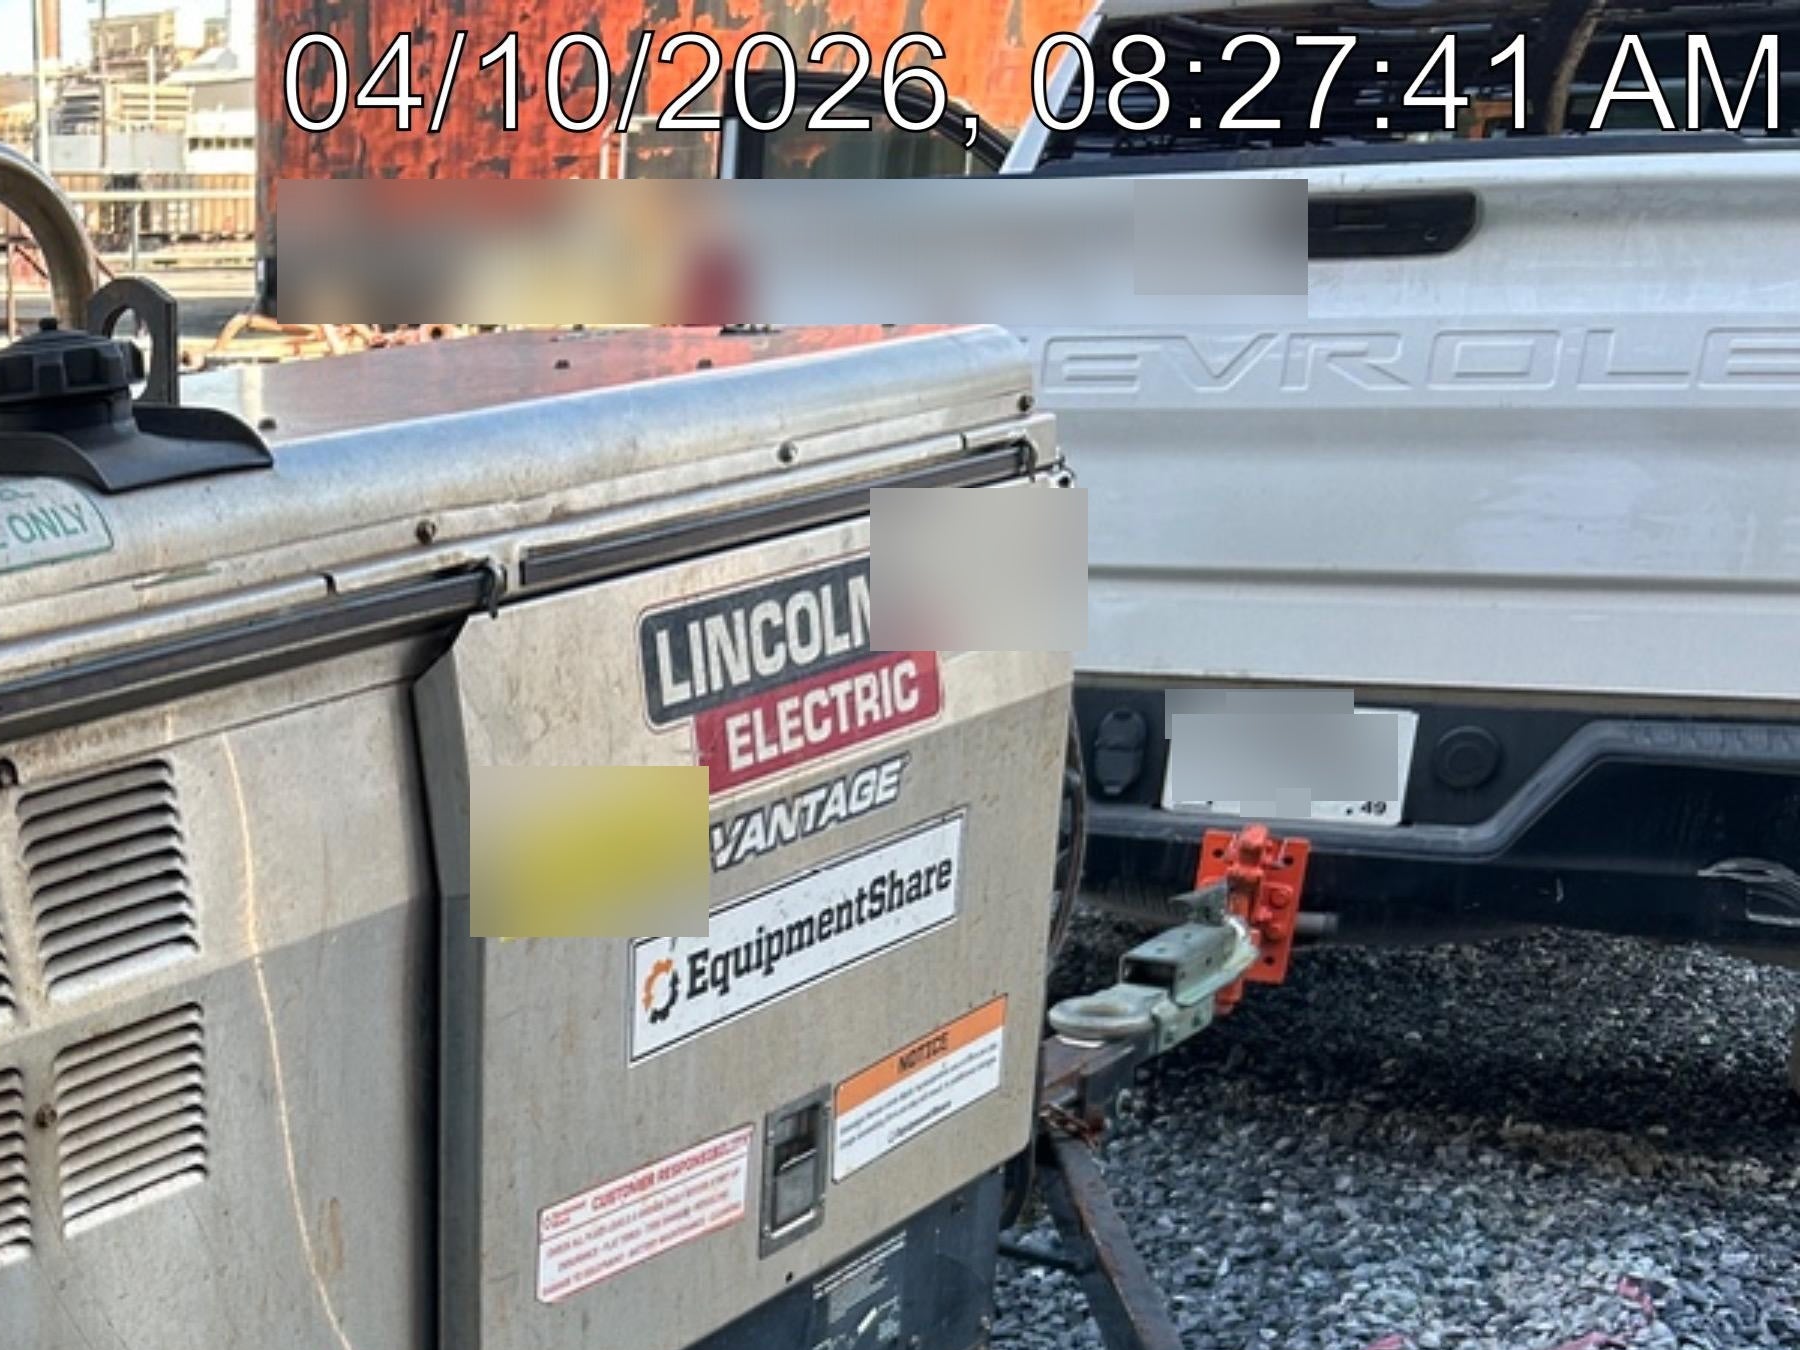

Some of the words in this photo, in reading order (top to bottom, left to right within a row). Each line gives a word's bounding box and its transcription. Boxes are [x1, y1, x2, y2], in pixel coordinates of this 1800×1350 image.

[6, 502, 89, 544] ONLY
[724, 658, 920, 772] ELECTRIC
[709, 756, 906, 872] VANTAGE
[686, 856, 953, 1000] EquipmentShare
[899, 1030, 949, 1071] NOTICE
